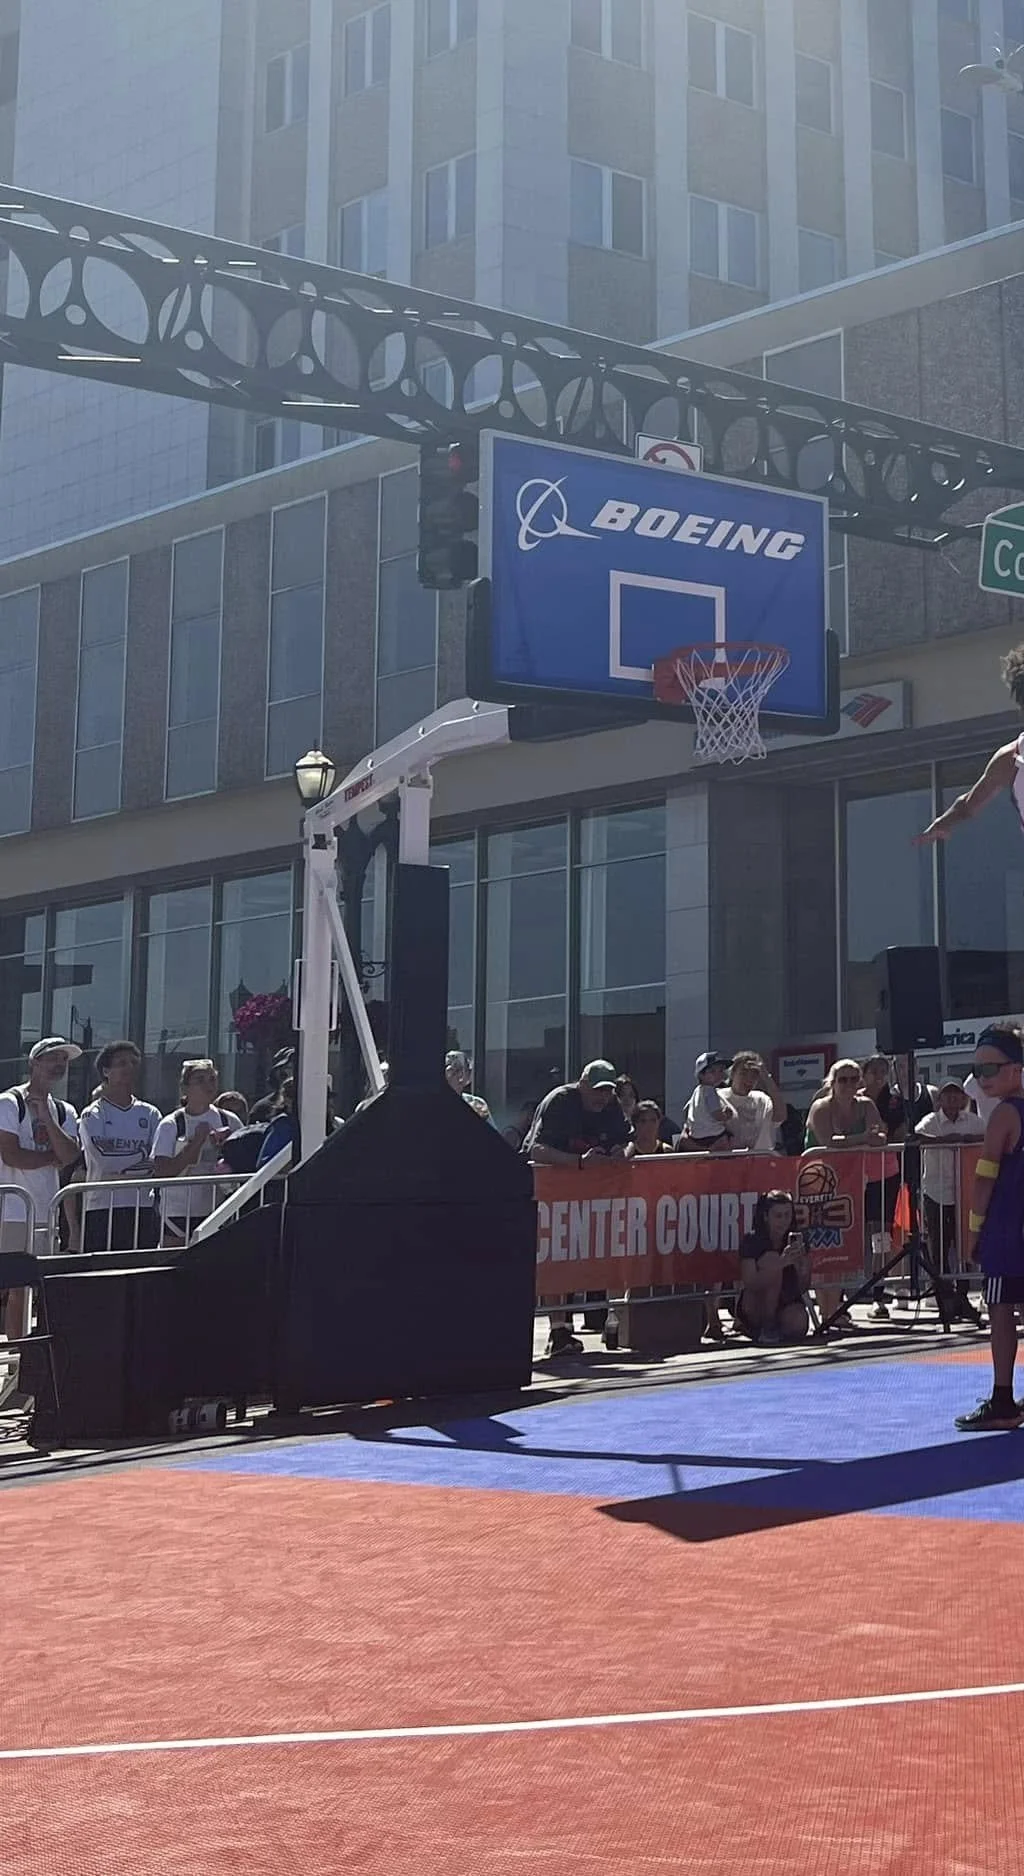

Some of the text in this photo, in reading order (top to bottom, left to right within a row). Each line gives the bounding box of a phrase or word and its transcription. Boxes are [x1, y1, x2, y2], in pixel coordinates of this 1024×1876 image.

[590, 499, 805, 561] BOEING
[943, 1027, 976, 1048] erica
[536, 1191, 759, 1265] CENTER COURT
